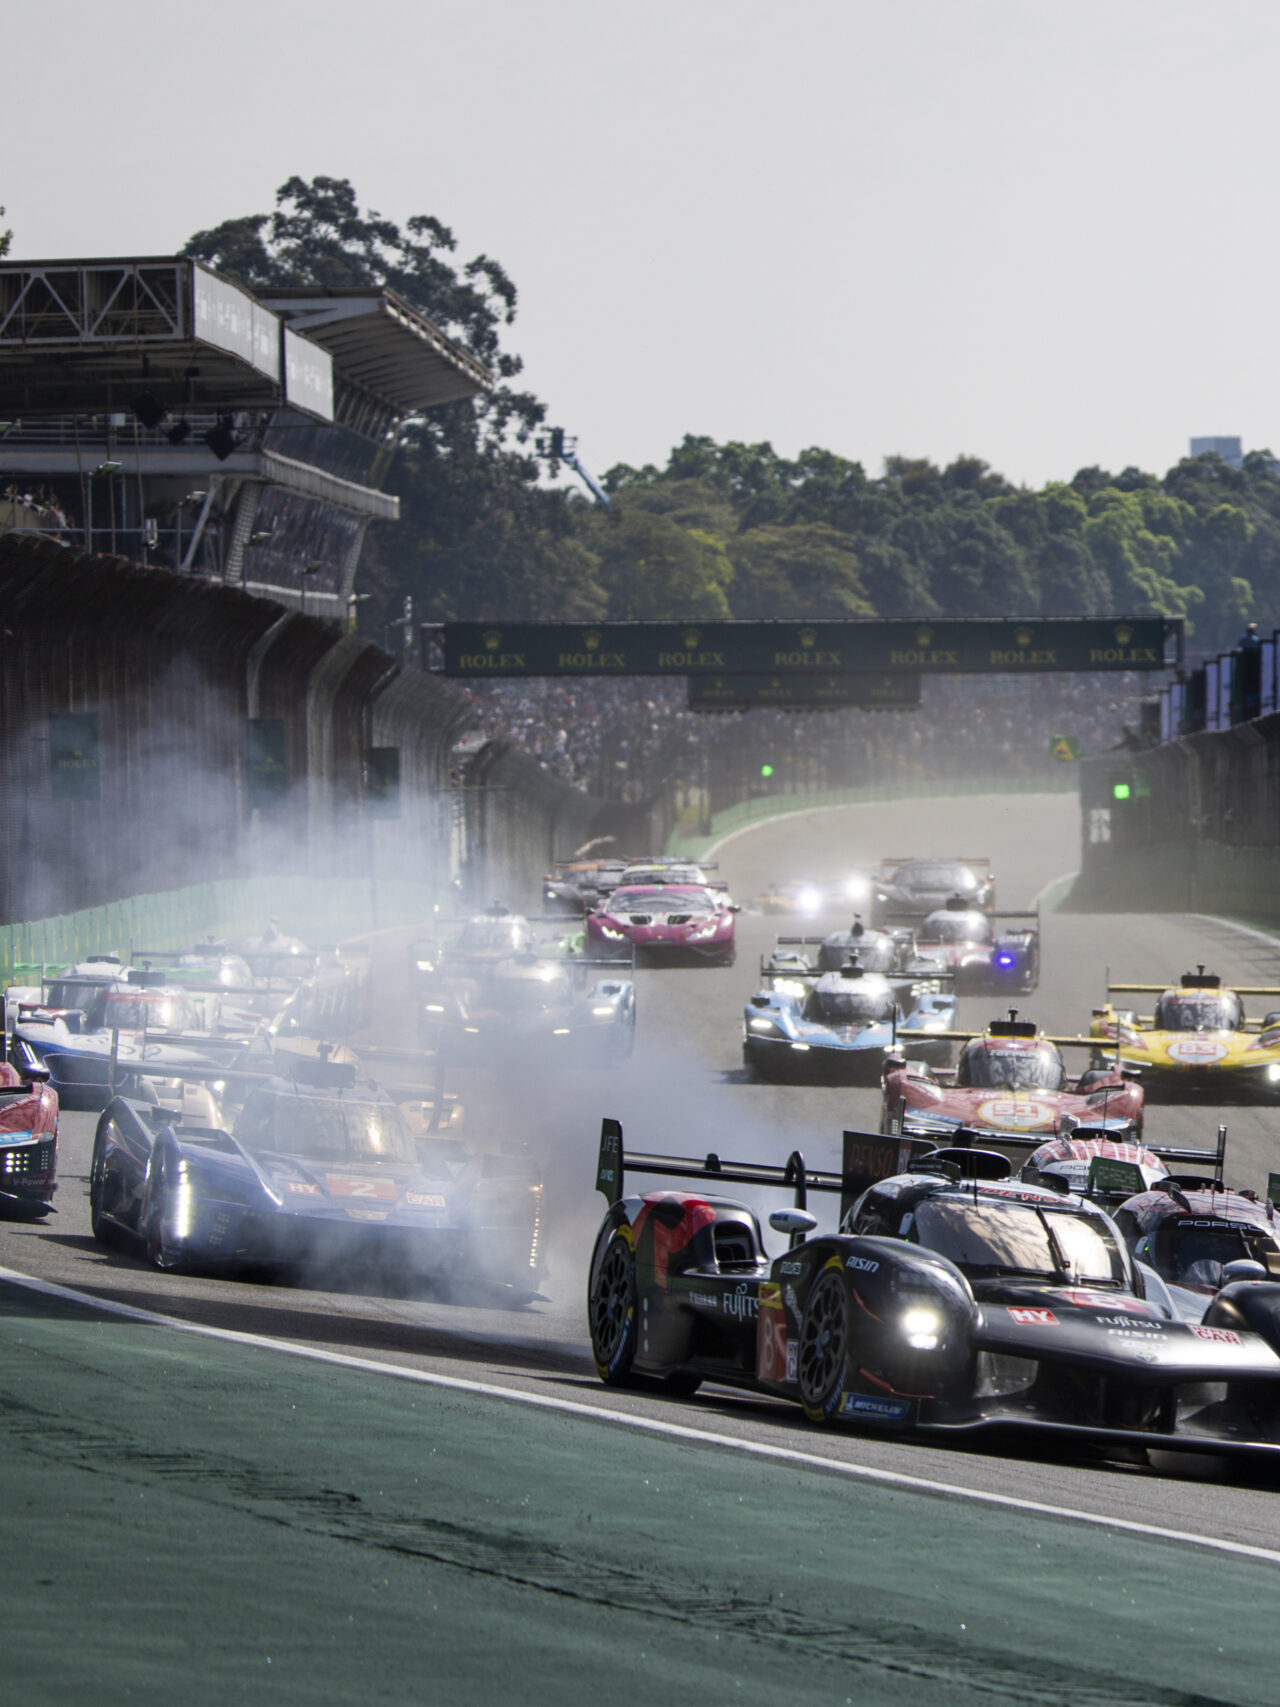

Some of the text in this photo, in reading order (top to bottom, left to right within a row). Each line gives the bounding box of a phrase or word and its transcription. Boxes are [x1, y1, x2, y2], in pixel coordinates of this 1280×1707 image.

[459, 649, 1157, 669] ROLEX ROLEX ROLEX ROLEX ROLEX ROLEX ROLEX
[601, 1136, 619, 1153] JFE
[850, 1143, 895, 1178] DENSO
[349, 1181, 379, 1199] 2
[1178, 1220, 1265, 1232] PORSC
[846, 1256, 880, 1274] AISIN
[723, 1293, 759, 1322] FUJITS
[1011, 1309, 1051, 1323] HY
[1096, 1314, 1162, 1330] FUJITSU
[763, 1315, 774, 1371] 8
[1197, 1331, 1240, 1345] CAR
[854, 1401, 902, 1415] MICHELIN
